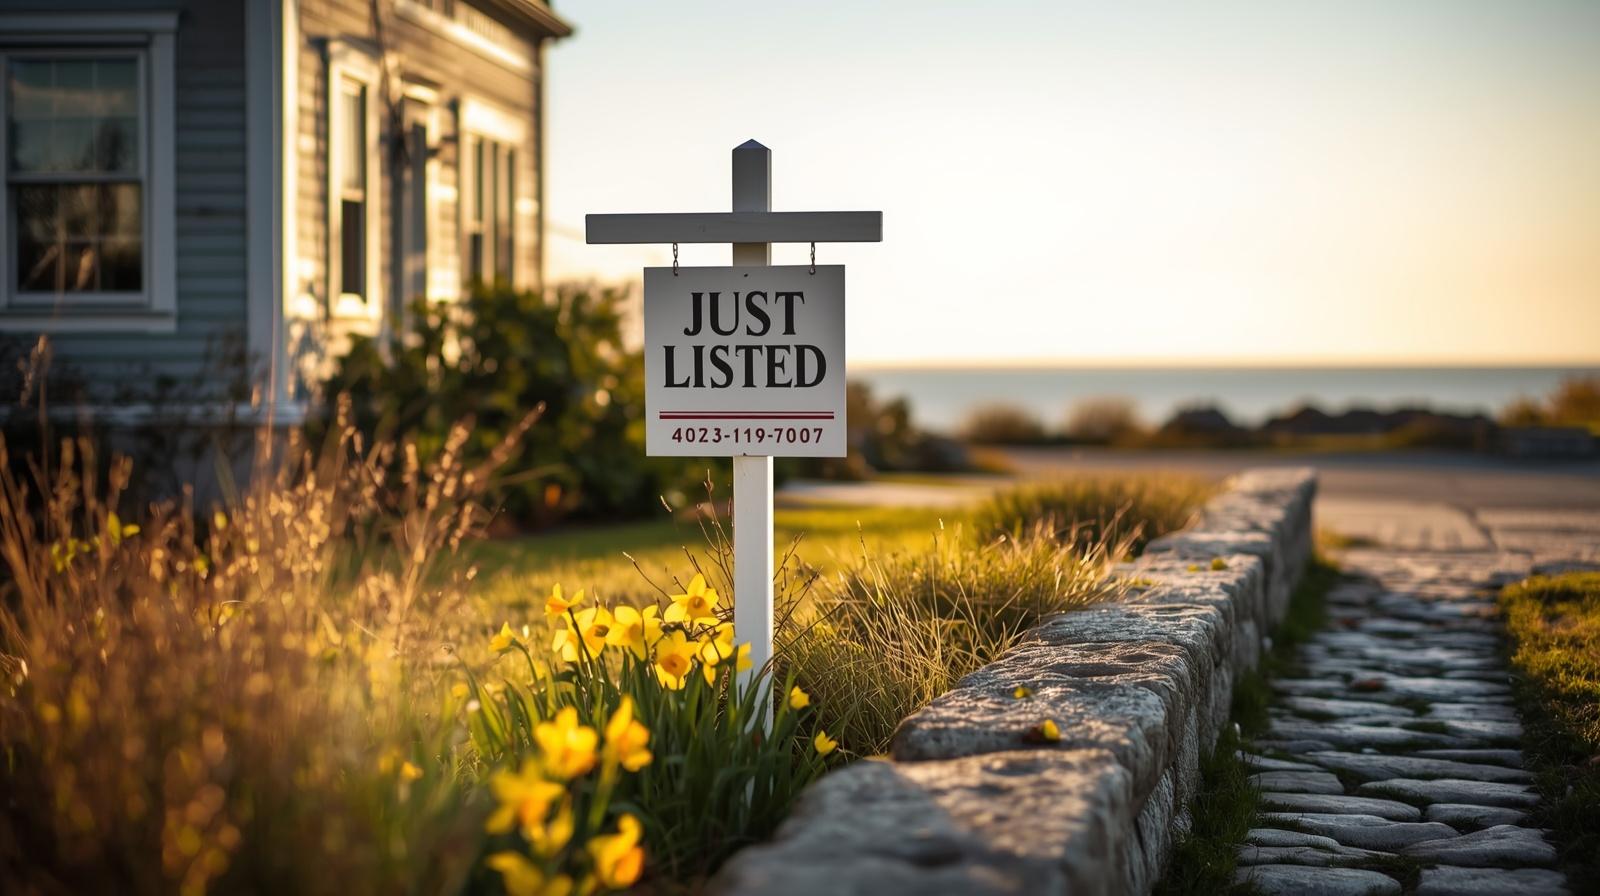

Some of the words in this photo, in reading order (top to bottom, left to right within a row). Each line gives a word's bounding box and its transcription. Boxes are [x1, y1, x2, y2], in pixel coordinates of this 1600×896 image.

[683, 291, 806, 337] JUST
[663, 344, 827, 389] LISTED
[671, 427, 824, 444] 4023-119-7007
